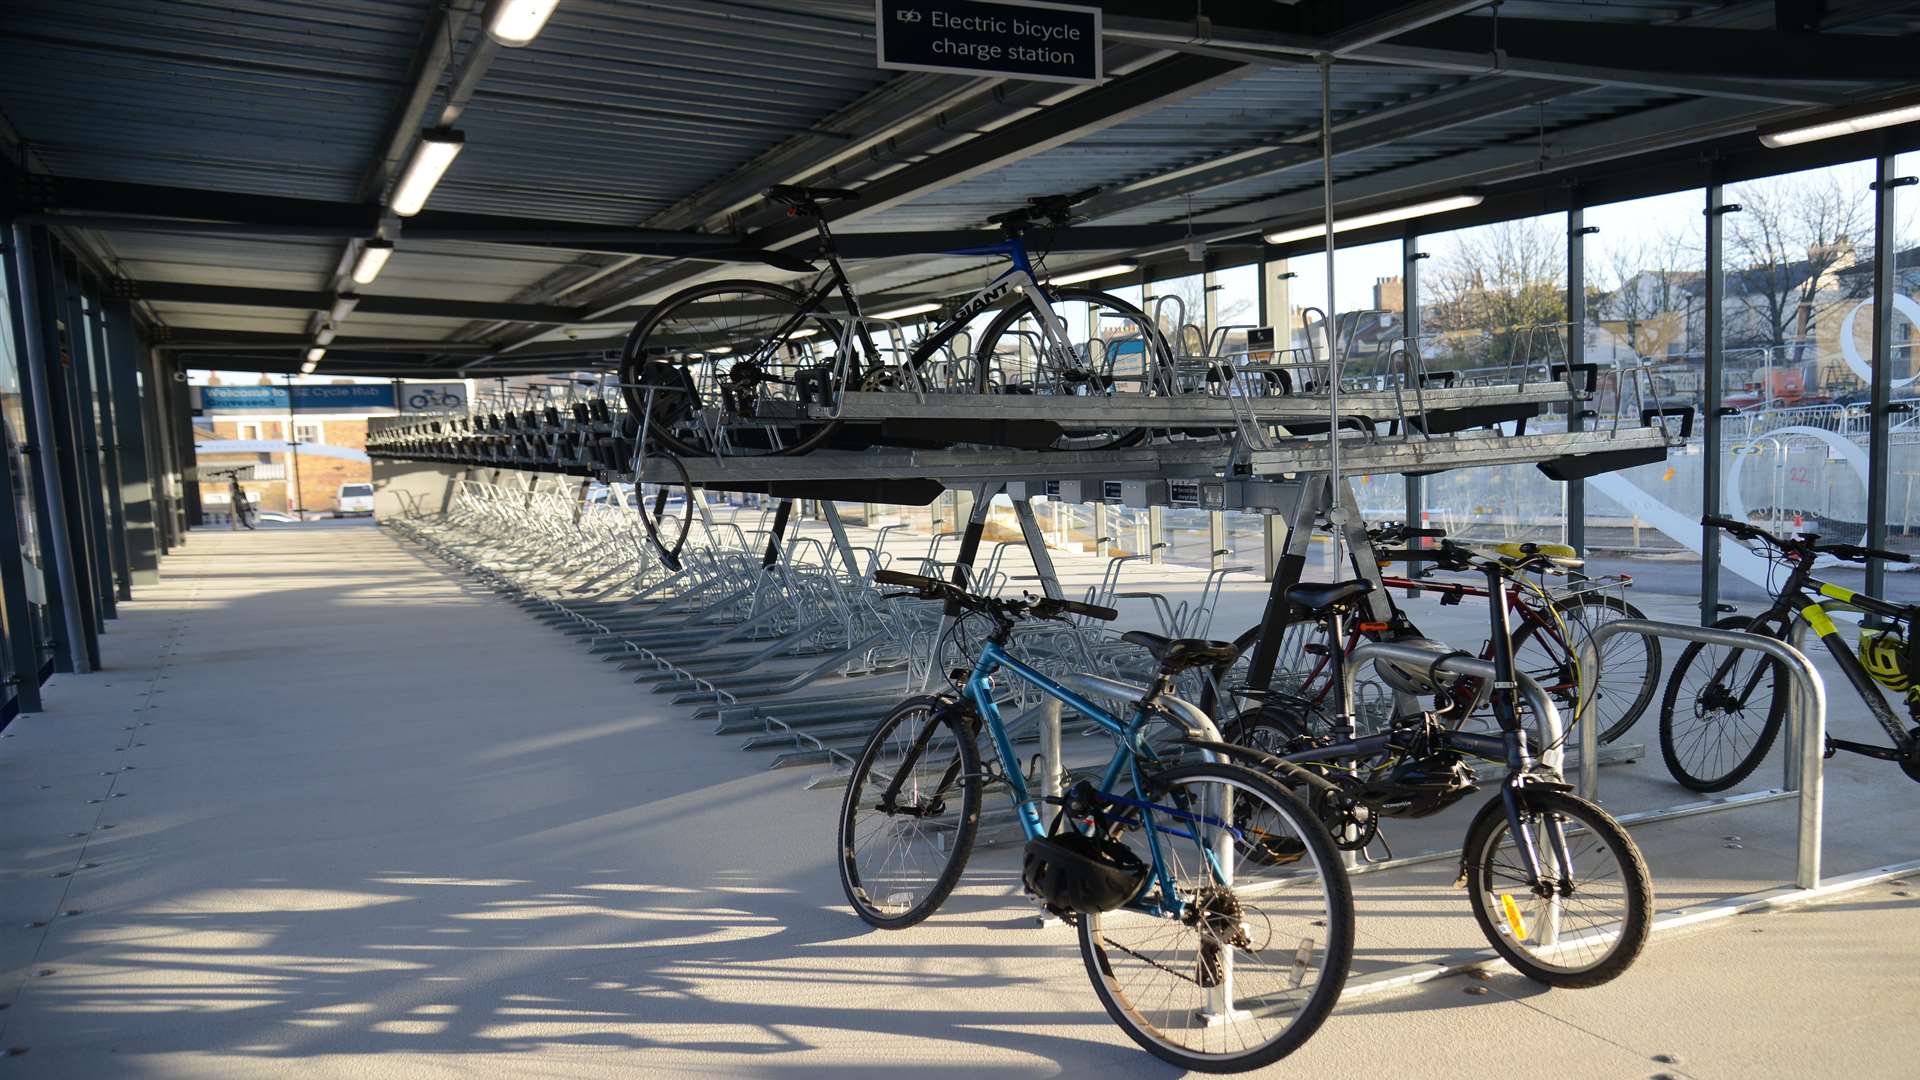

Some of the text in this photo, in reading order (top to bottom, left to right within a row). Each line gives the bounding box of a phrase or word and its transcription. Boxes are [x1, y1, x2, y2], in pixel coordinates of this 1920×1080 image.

[931, 10, 1080, 42] Electric bicycle
[931, 38, 1075, 65] charge station
[953, 281, 1009, 321] GIANT
[207, 388, 286, 398] Welcome to
[311, 388, 350, 398] Cycle
[352, 387, 379, 397] Hub
